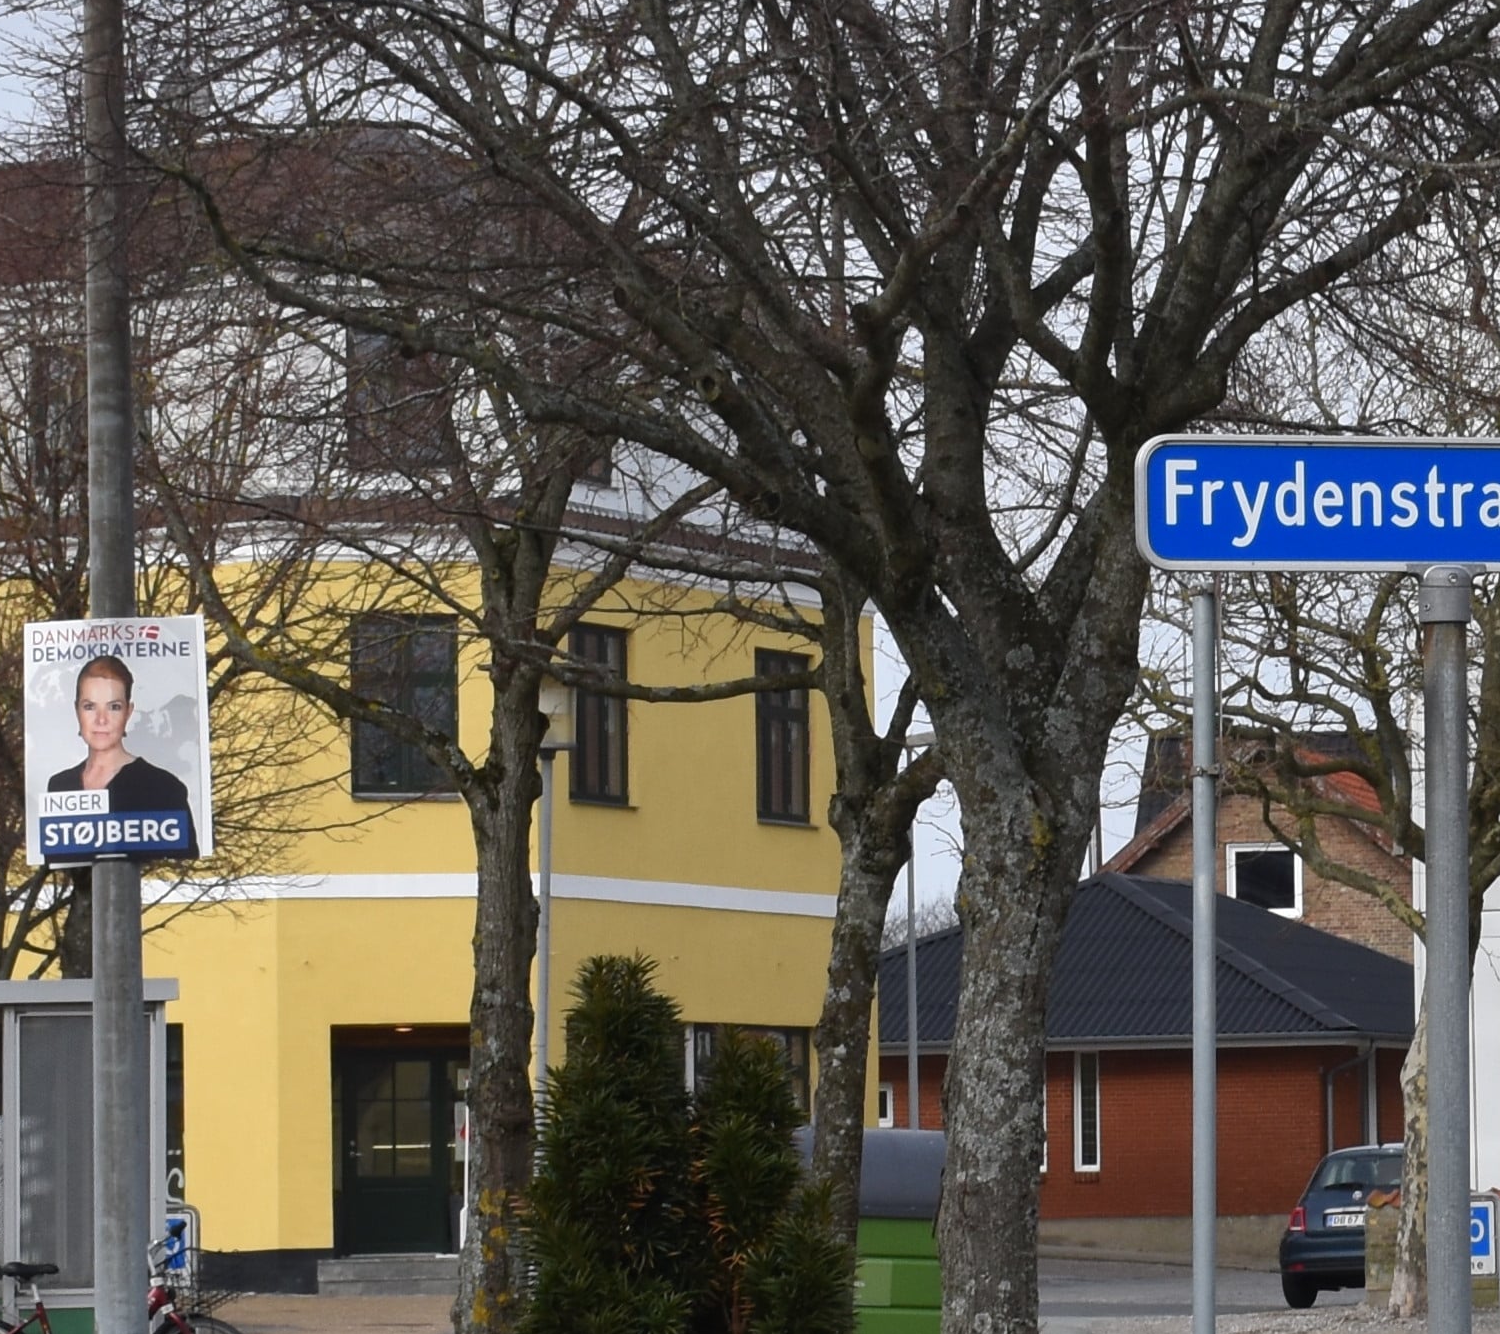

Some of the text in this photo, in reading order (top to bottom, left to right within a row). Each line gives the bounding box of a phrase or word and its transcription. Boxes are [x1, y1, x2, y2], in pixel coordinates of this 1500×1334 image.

[32, 625, 136, 646] DANMARKS
[32, 641, 191, 663] DEMOKRATERNE
[43, 793, 102, 812] INGER
[44, 818, 181, 848] STØJBERG
